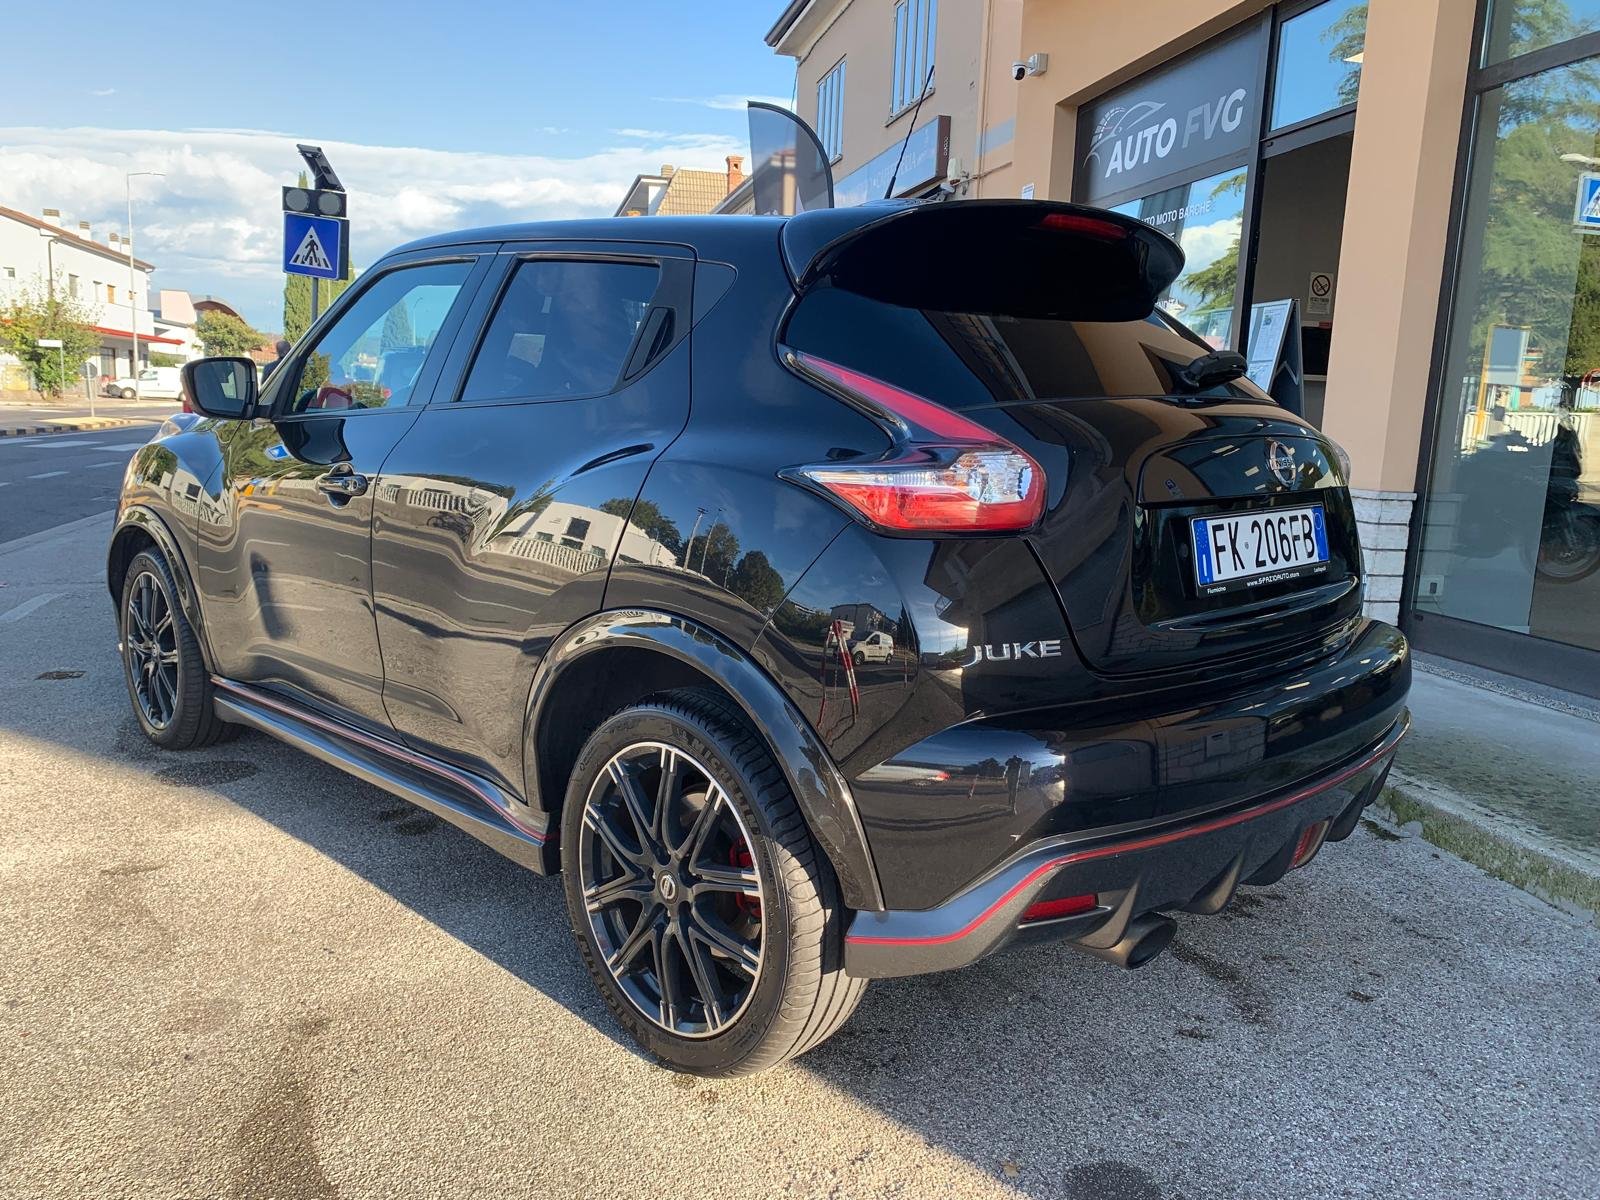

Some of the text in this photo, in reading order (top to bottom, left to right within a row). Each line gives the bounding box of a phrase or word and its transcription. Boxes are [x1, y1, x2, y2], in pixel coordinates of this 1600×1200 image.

[1105, 88, 1247, 178] AUTO FVG
[1156, 209, 1178, 226] MOTO
[1211, 513, 1315, 575] FK 206FB
[961, 639, 1062, 668] JUKE
